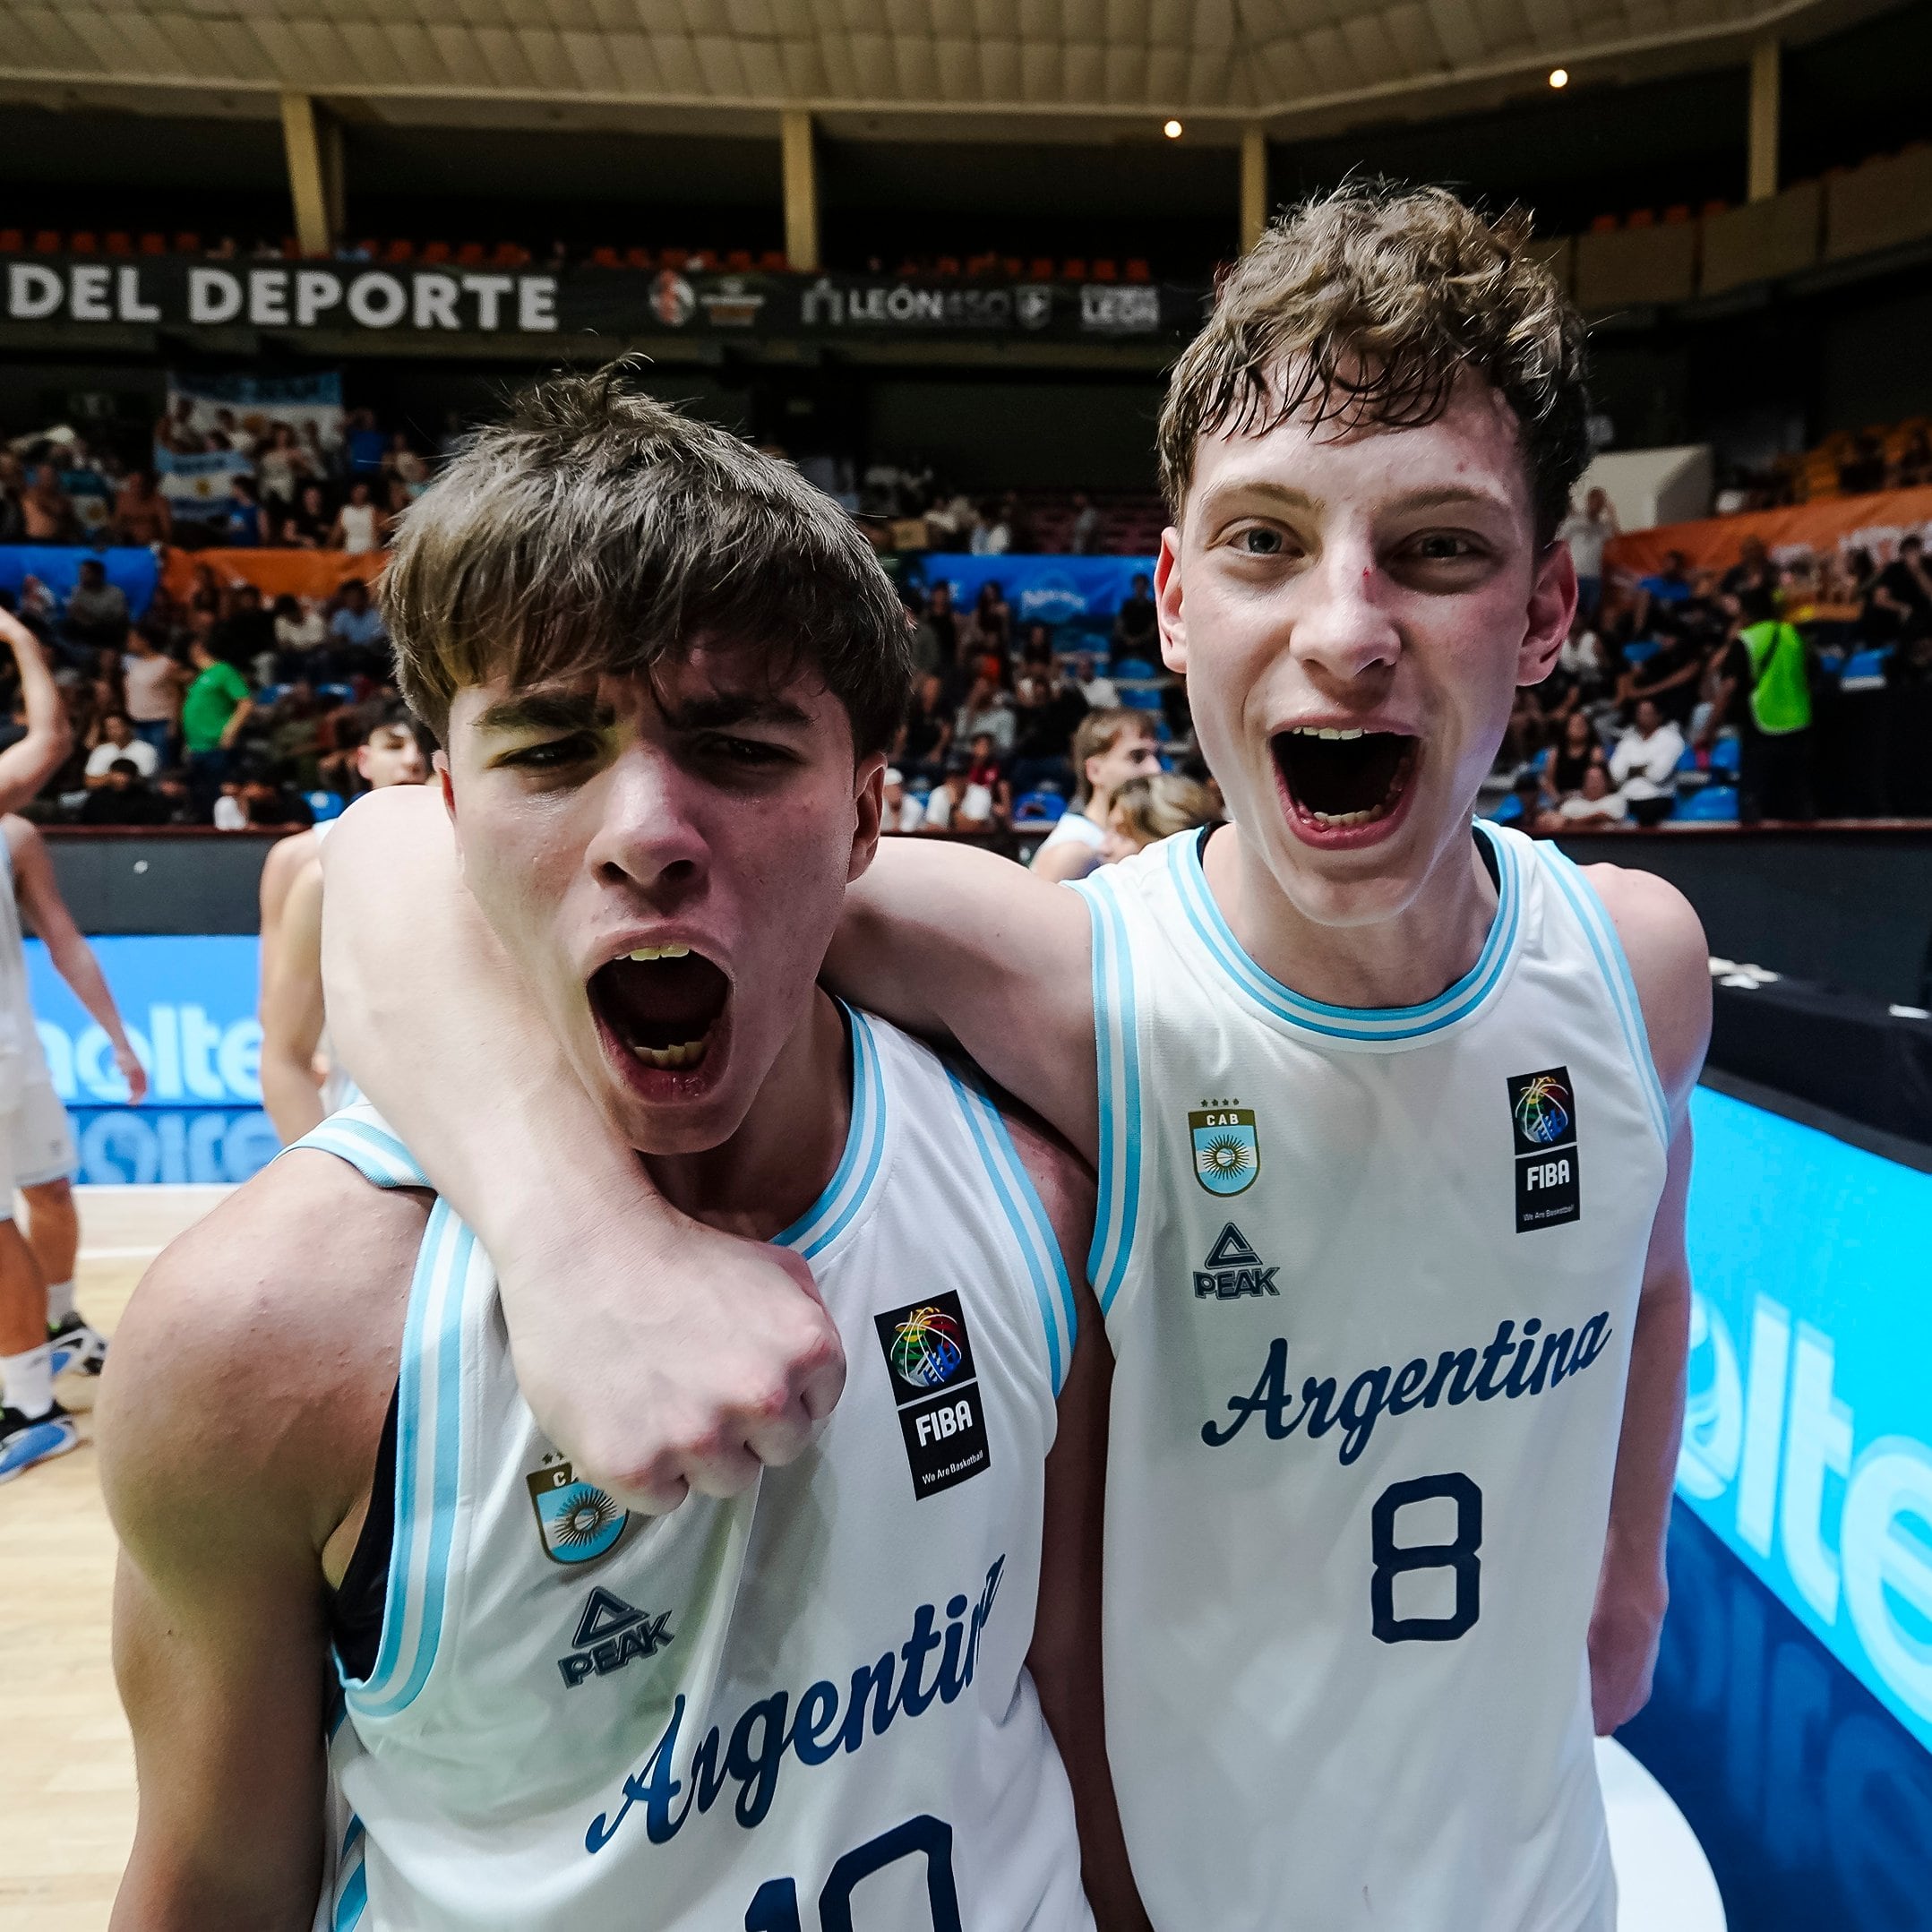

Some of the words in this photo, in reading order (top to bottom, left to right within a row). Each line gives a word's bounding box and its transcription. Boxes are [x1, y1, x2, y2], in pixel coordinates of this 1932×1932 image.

[9, 264, 159, 322] DEL
[188, 269, 557, 331] DEPORTE
[1206, 1113, 1239, 1126] CAB
[1527, 1159, 1570, 1190] FIBA
[1193, 1267, 1281, 1300] PEAK
[1201, 1310, 1612, 1465] Argentina
[915, 1400, 974, 1447] FIBA
[922, 1473, 936, 1485] We
[937, 1467, 950, 1480] Are
[949, 1449, 983, 1473] Basketball
[1371, 1472, 1482, 1644] 8
[558, 1610, 675, 1689] PEAK
